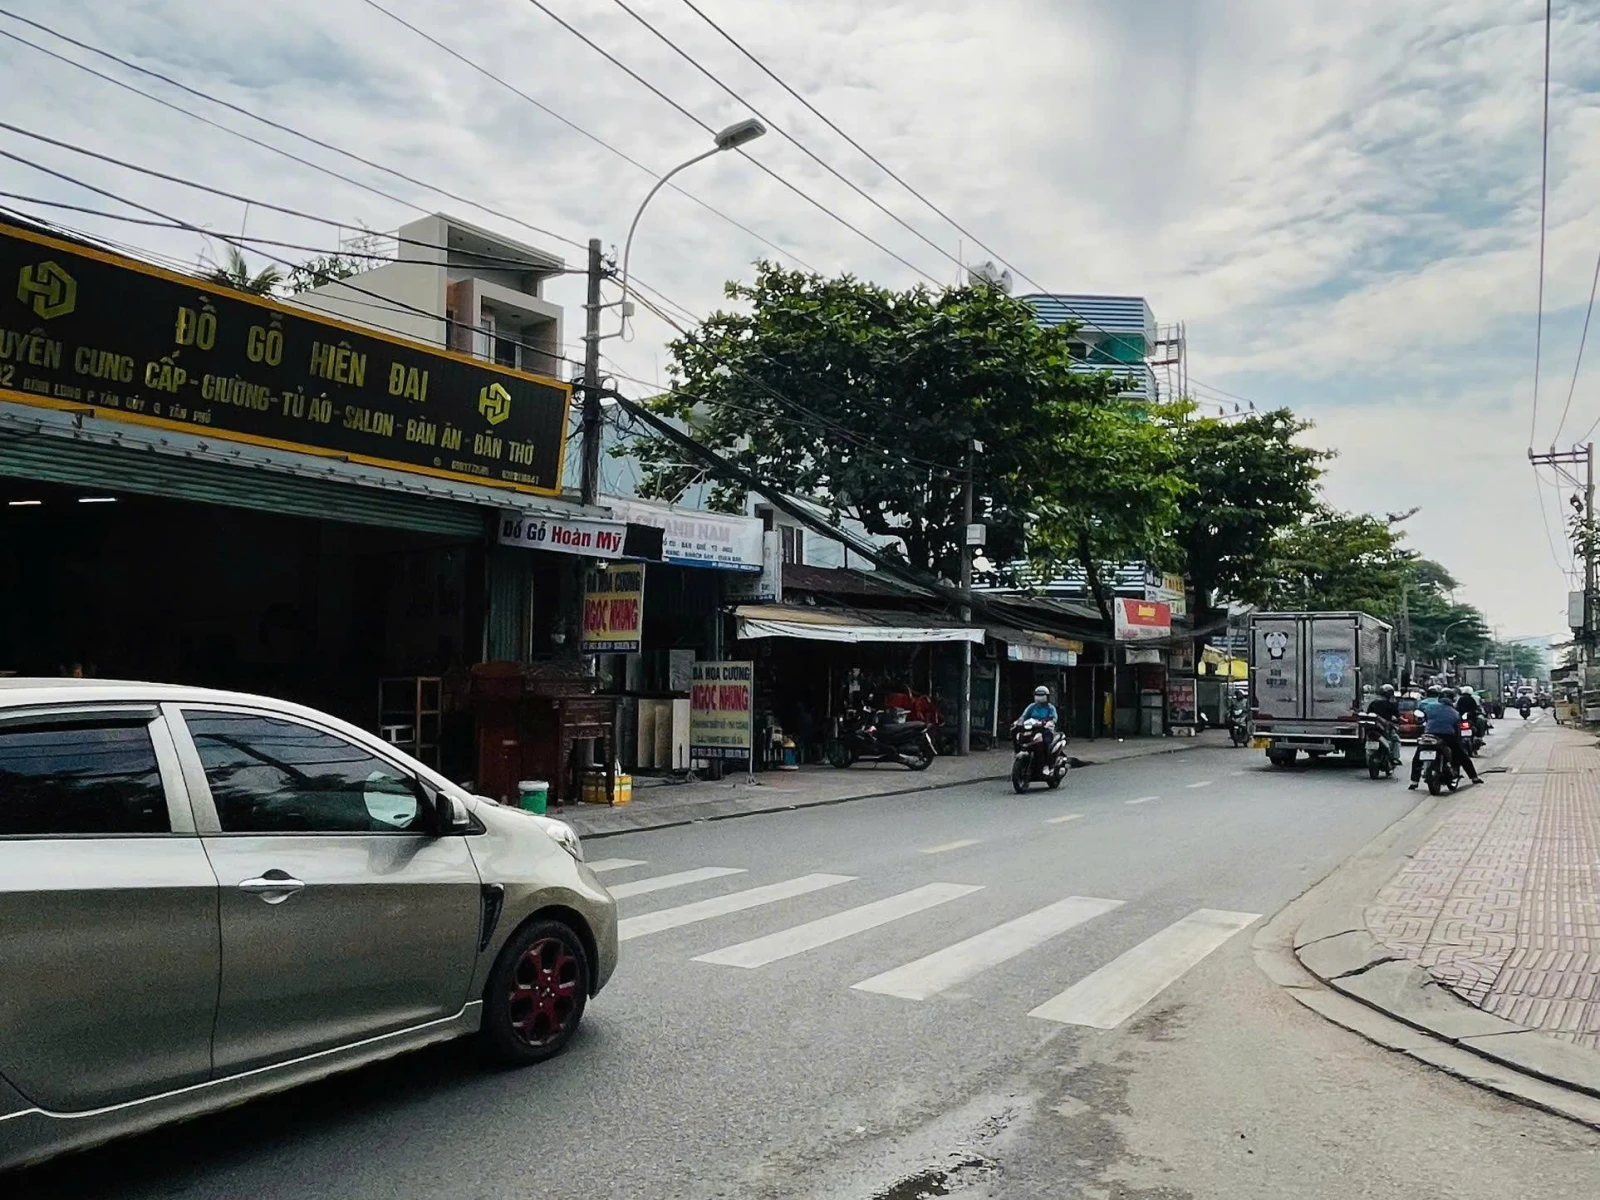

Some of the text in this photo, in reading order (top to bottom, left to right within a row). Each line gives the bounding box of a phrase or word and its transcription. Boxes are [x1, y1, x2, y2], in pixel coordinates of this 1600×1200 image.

[175, 295, 217, 350] ĐỒ
[247, 312, 284, 367] GỖ
[75, 346, 135, 384] CUNG
[145, 350, 187, 393] CẤP
[342, 404, 394, 437] SALON
[551, 526, 591, 547] Hoàn
[596, 531, 622, 553] Mỹ
